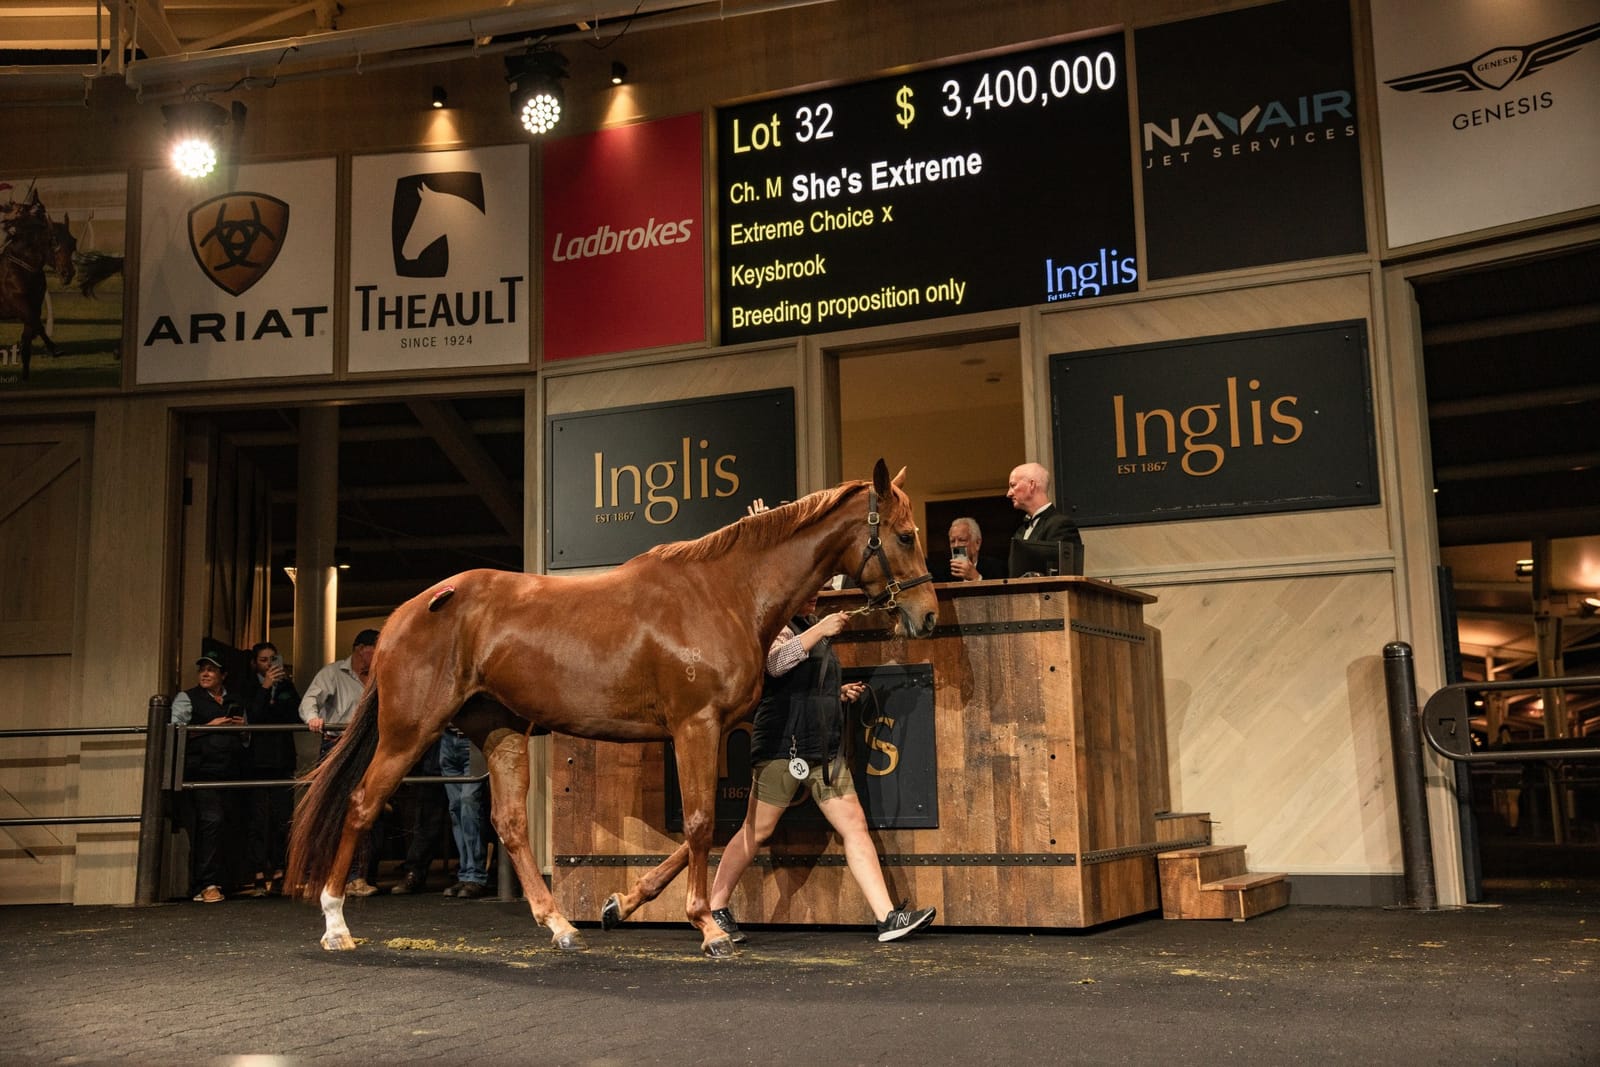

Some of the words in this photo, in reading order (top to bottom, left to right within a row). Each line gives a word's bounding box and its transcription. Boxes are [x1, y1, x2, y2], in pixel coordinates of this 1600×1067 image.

[1477, 55, 1518, 72] GENESIS
[733, 113, 781, 154] Lot
[795, 103, 834, 143] 32
[896, 85, 915, 129] $
[941, 51, 1117, 120] 3,400,000
[1143, 90, 1353, 151] NAVAIR
[1452, 91, 1553, 130] GENESIS
[1146, 152, 1190, 168] JET
[1213, 125, 1355, 158] SERVICES
[730, 181, 760, 204] Ch.
[766, 176, 782, 199] M
[792, 168, 862, 203] She's
[871, 152, 982, 191] Extreme
[552, 217, 694, 262] Ladbrokes
[731, 218, 804, 245] Extreme
[810, 207, 874, 233] Choice
[882, 205, 894, 223] x
[731, 254, 826, 288] Keysbrook
[1046, 248, 1137, 296] Inglis
[355, 276, 523, 331] THEAULT
[732, 300, 811, 328] Breeding
[818, 285, 919, 322] proposition
[925, 277, 966, 305] only
[143, 306, 328, 346] ARIAT
[400, 336, 437, 348] SINCE
[444, 335, 473, 347] 1924
[1113, 376, 1304, 476] Inglis
[594, 437, 740, 525] Inglis
[1118, 463, 1137, 474] EST
[1141, 461, 1168, 472] 1867
[595, 513, 611, 523] EST
[614, 511, 635, 522] 1867
[793, 762, 806, 776] 32
[721, 787, 750, 799] 1867
